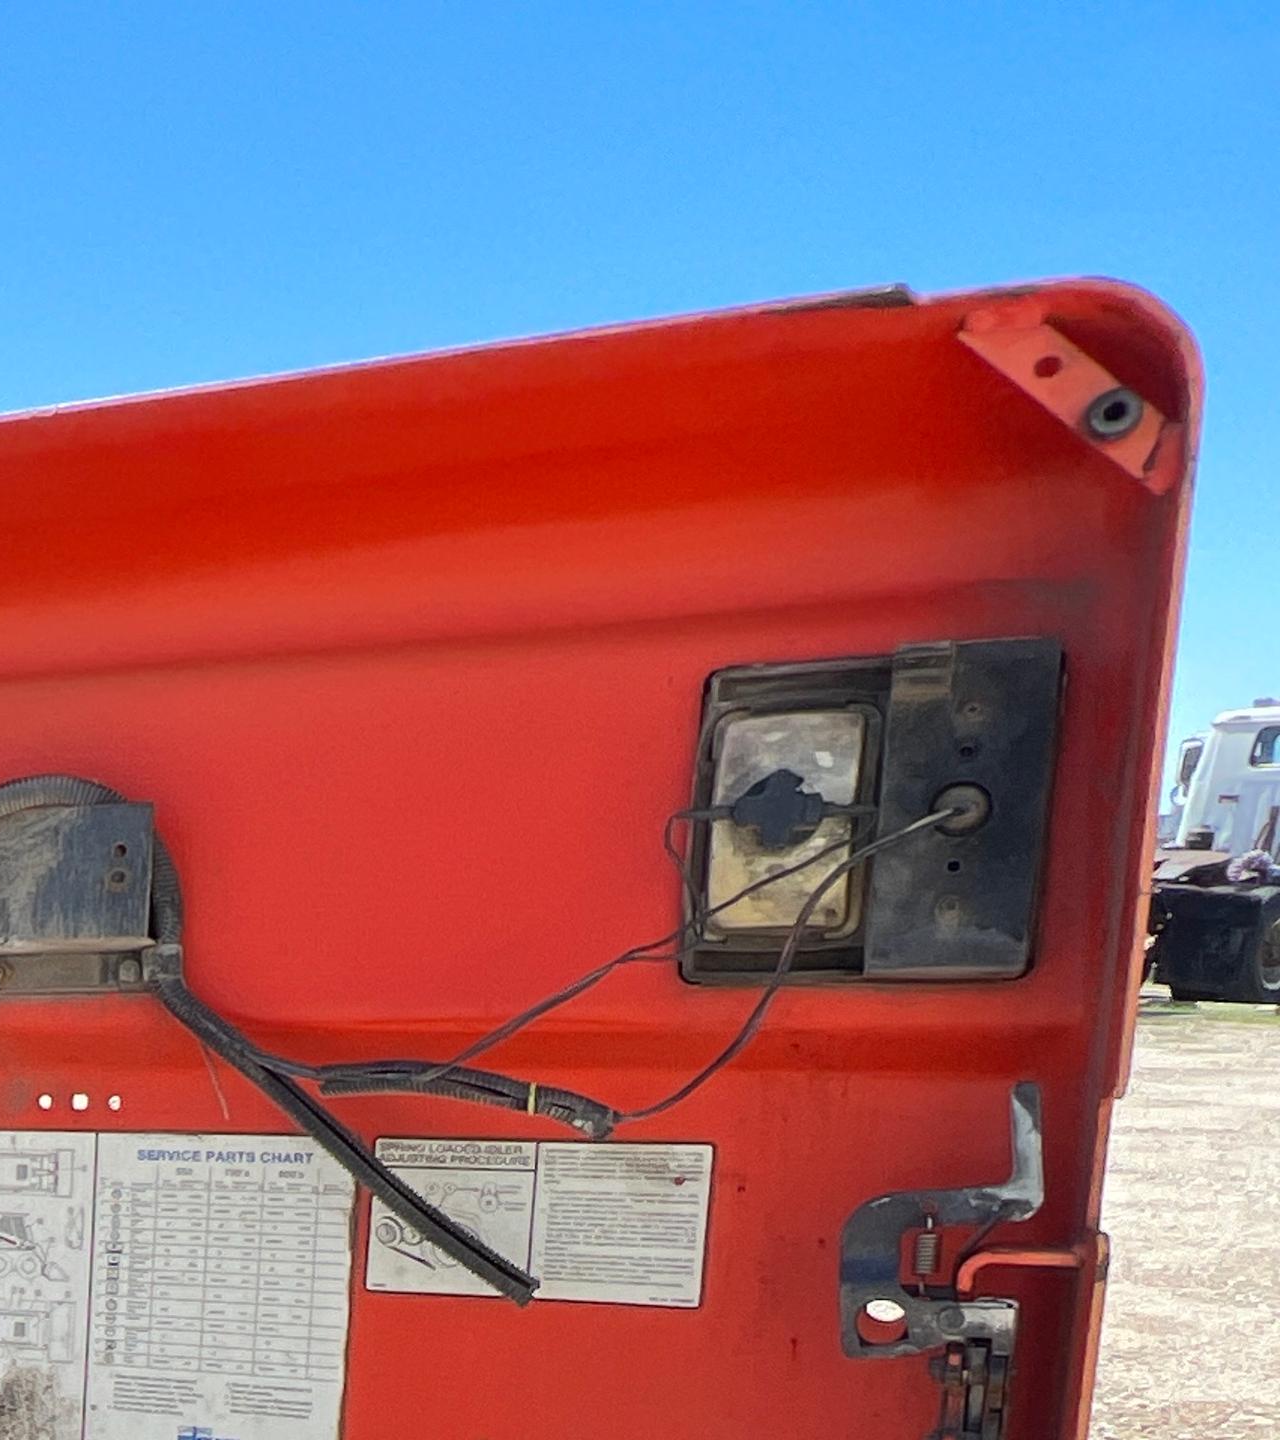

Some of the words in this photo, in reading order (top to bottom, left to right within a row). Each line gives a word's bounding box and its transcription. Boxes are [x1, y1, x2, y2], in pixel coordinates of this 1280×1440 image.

[380, 1142, 426, 1152] SPRING
[137, 1149, 202, 1163] SERVICE
[206, 1150, 256, 1164] PARTS
[260, 1151, 315, 1165] CHART
